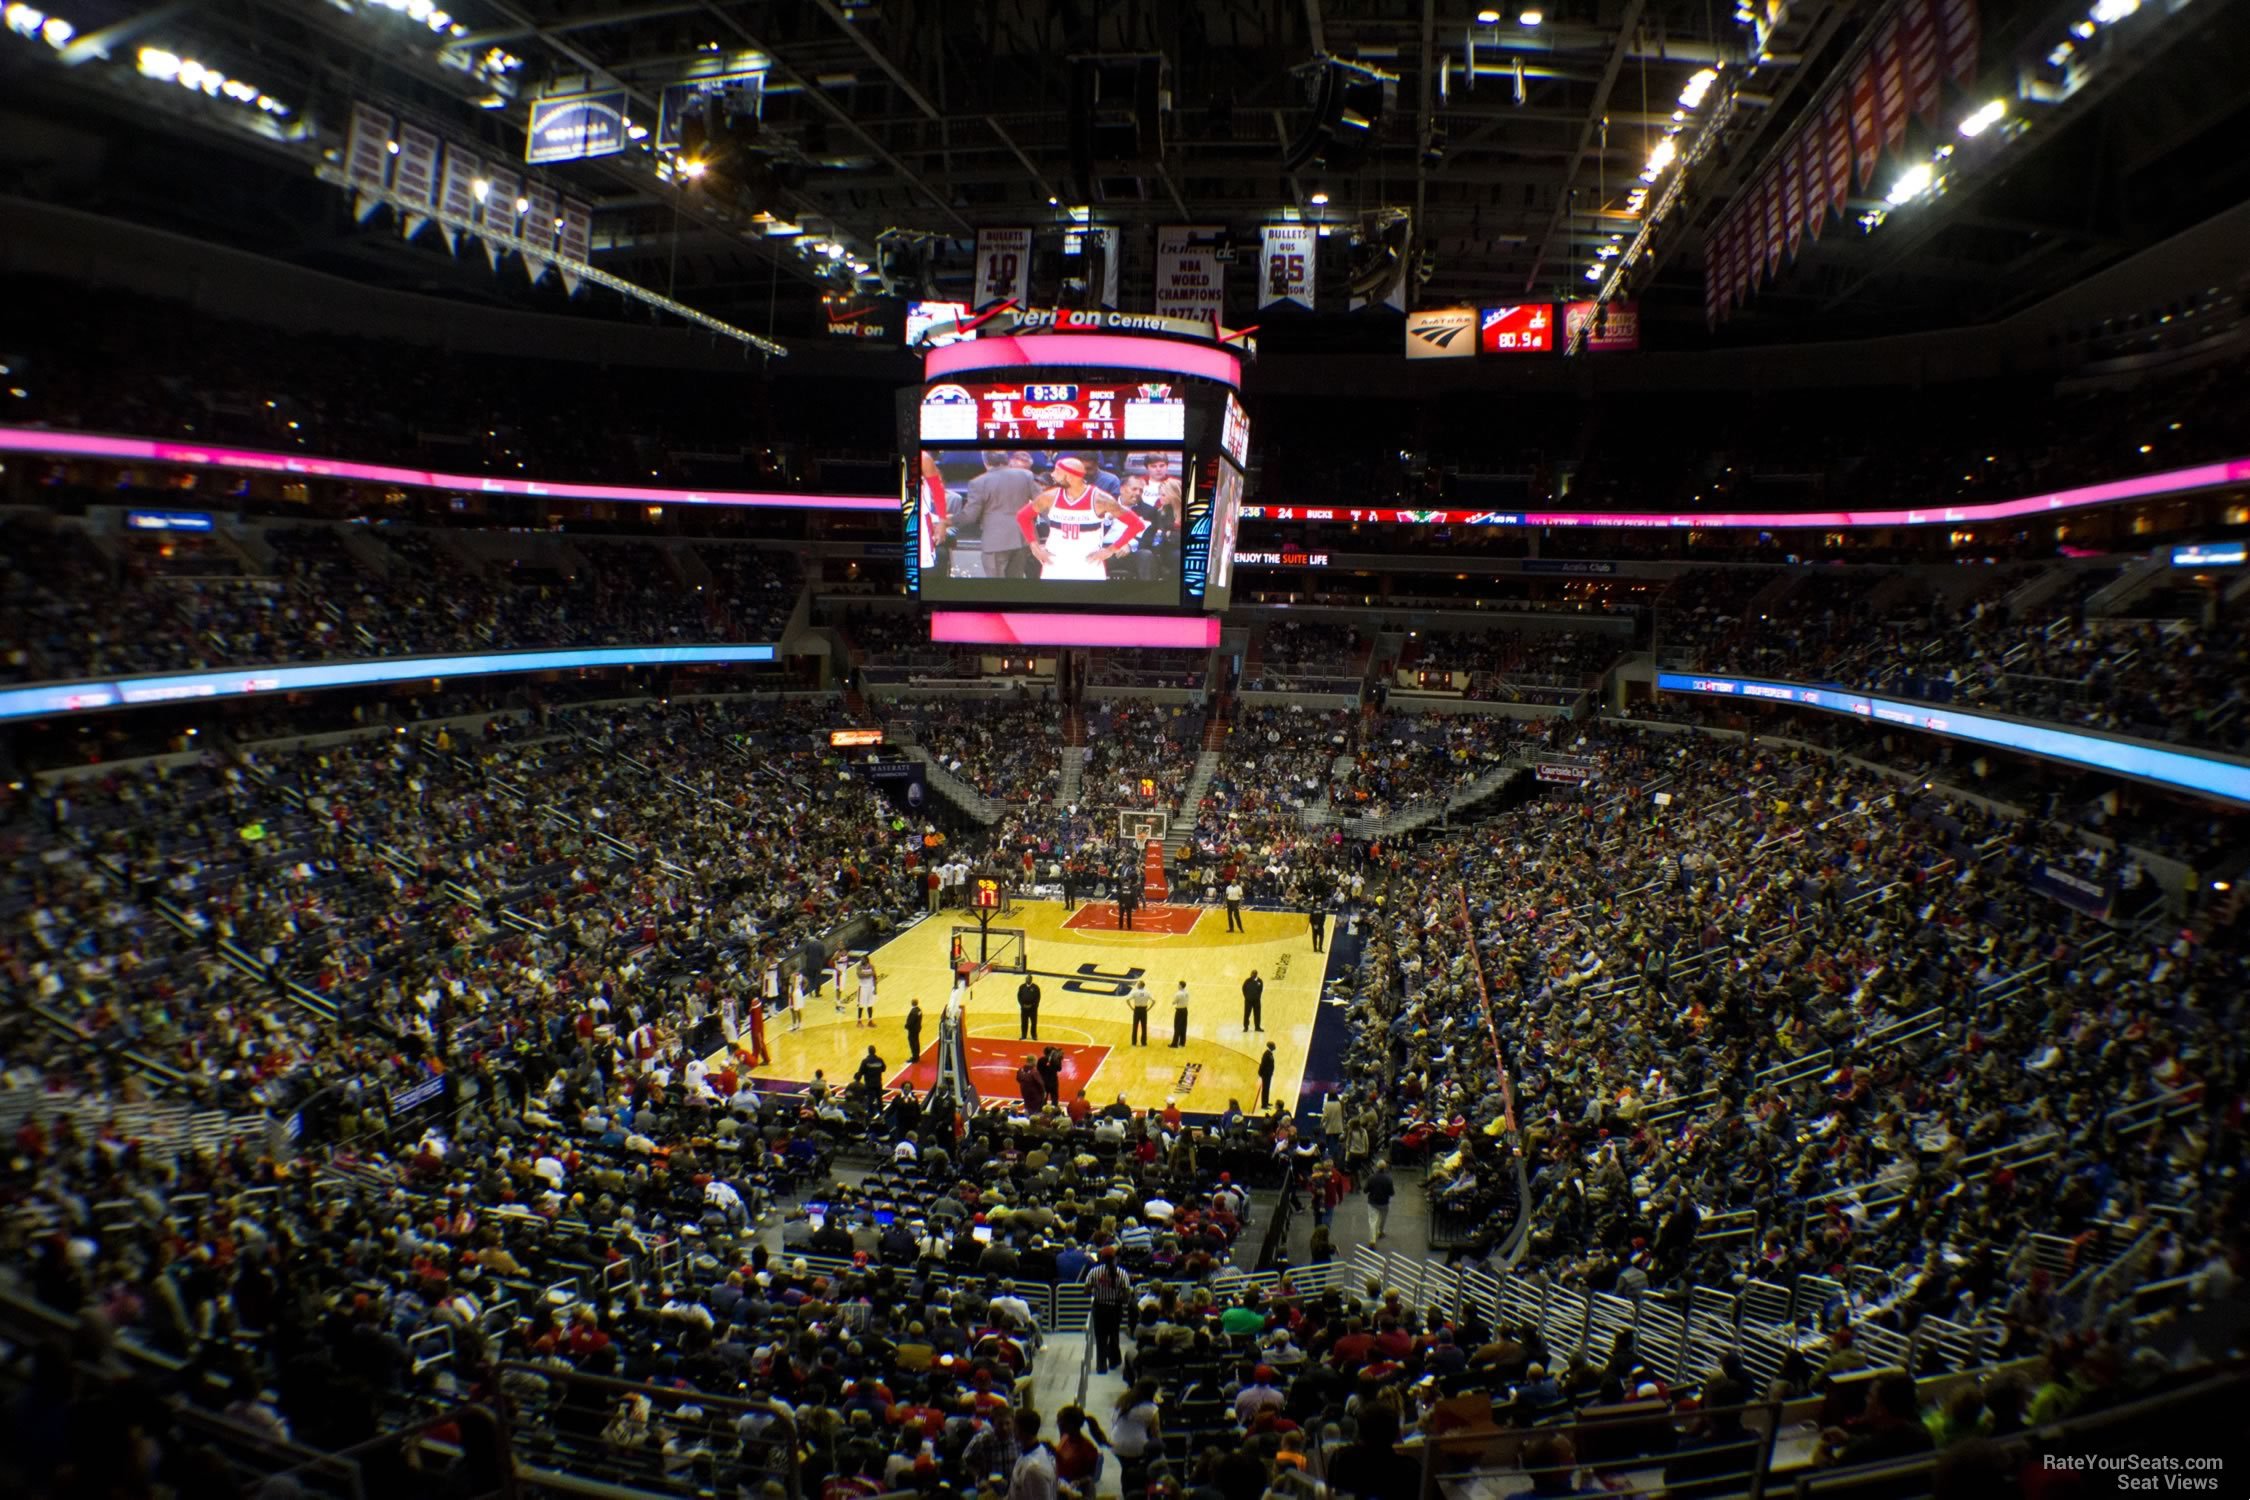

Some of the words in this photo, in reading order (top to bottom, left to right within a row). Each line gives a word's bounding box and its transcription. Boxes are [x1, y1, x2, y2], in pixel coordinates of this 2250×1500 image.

[986, 231, 1023, 240] BULLETS
[1269, 229, 1307, 239] BULLETS
[989, 254, 1017, 280] 10
[1179, 260, 1201, 272] NBA
[1270, 255, 1304, 282] 25
[1171, 275, 1209, 286] WORLD
[1158, 288, 1222, 300] CHAMPIONS
[1012, 306, 1100, 329] verizon
[1108, 312, 1168, 330] Center
[828, 321, 884, 336] verizon
[1034, 386, 1069, 400] 9:36
[1089, 391, 1115, 400] BUCKS
[992, 400, 1014, 420] 31
[1088, 400, 1111, 420] 24
[1278, 508, 1293, 519] 24
[1306, 510, 1334, 519] BUCKS
[1234, 552, 1262, 564] ENJOY
[1263, 553, 1280, 564] THE
[1283, 554, 1308, 564] SUITE
[1309, 555, 1328, 565] LIFE
[981, 890, 995, 905] 17
